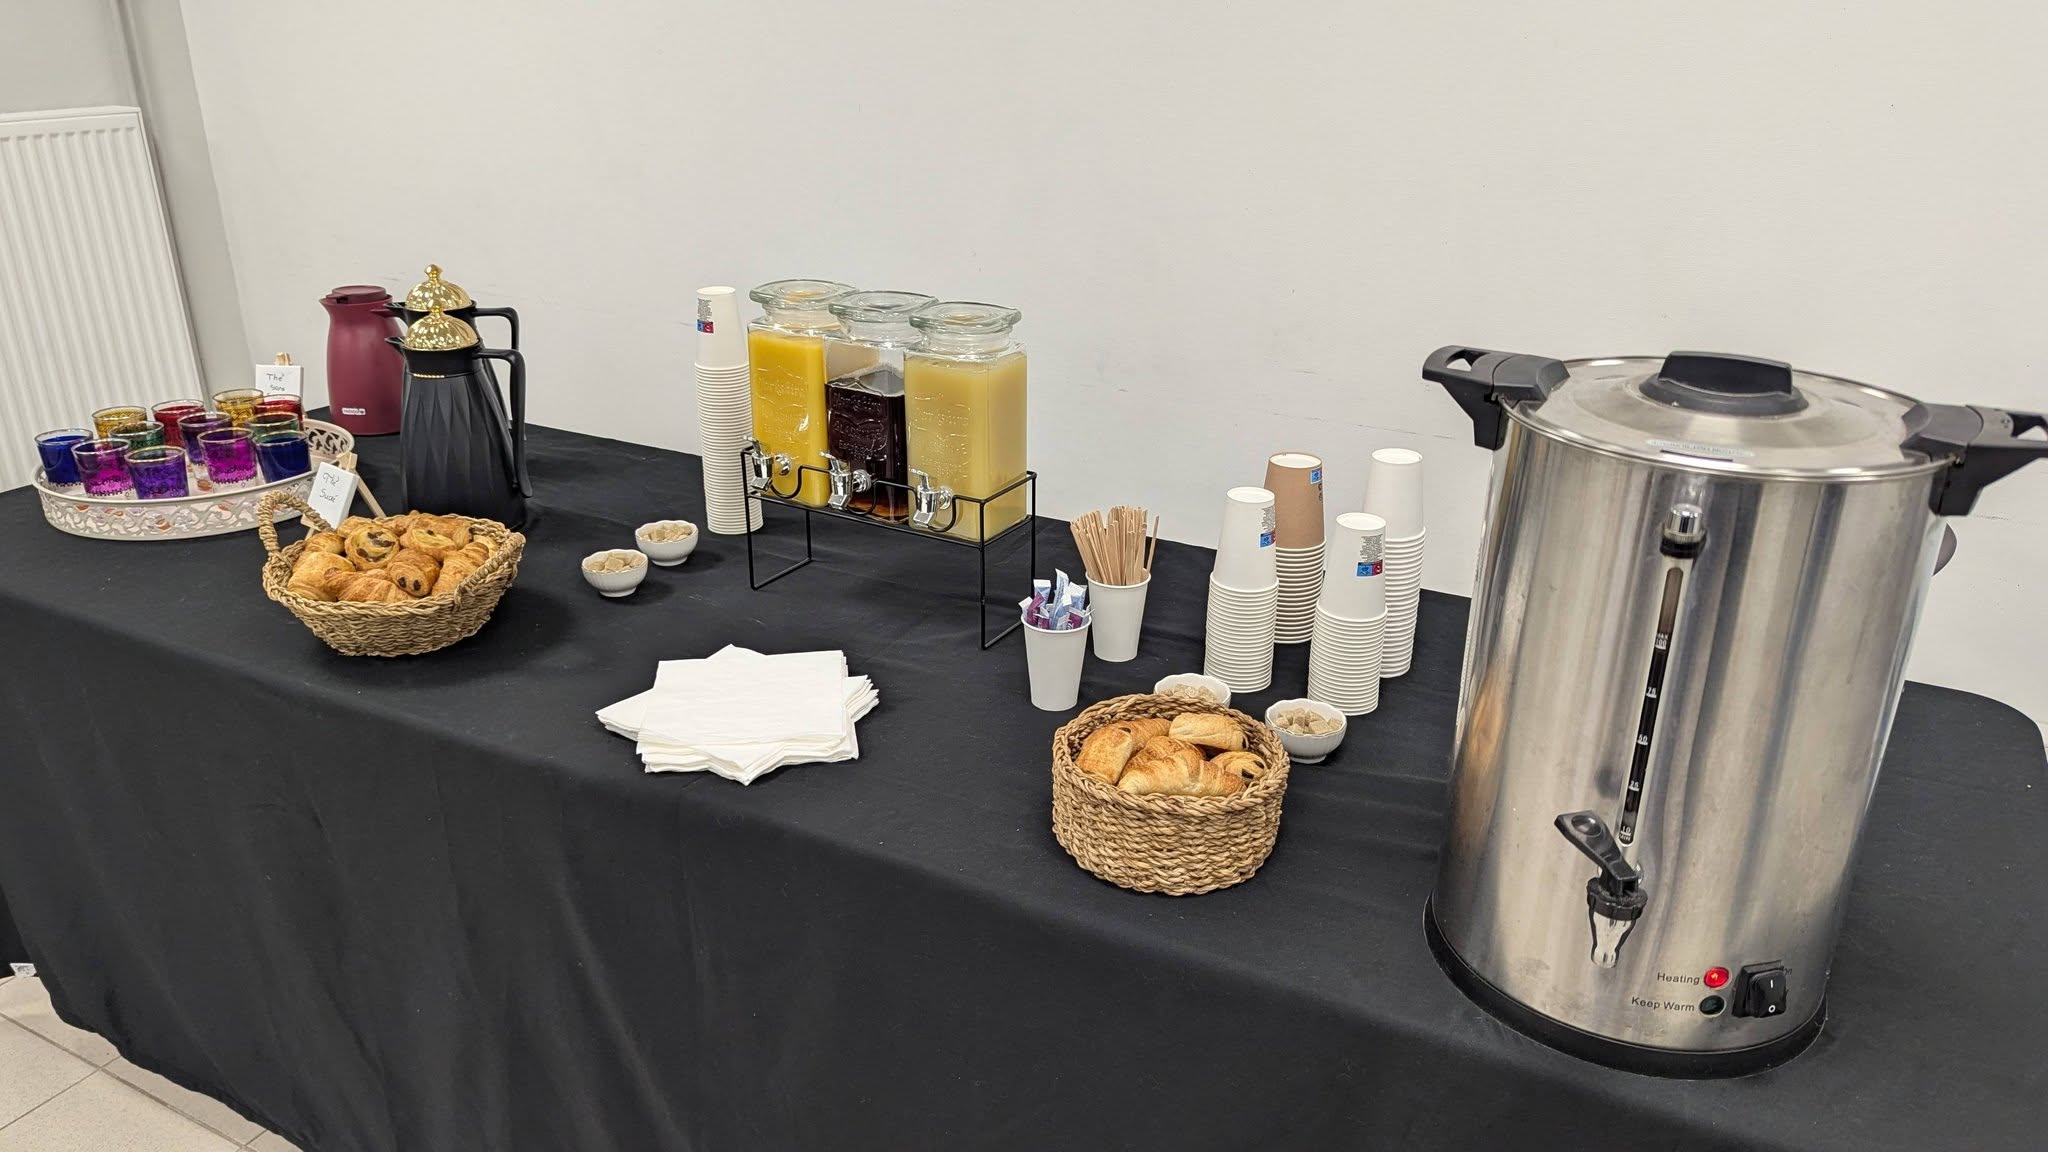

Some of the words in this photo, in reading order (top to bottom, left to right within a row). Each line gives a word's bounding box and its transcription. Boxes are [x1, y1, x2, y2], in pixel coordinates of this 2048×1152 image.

[1622, 825, 1631, 833] 10
[1656, 972, 1700, 986] Heating
[1631, 996, 1661, 1010] Keep
[1663, 1001, 1695, 1012] Warm
